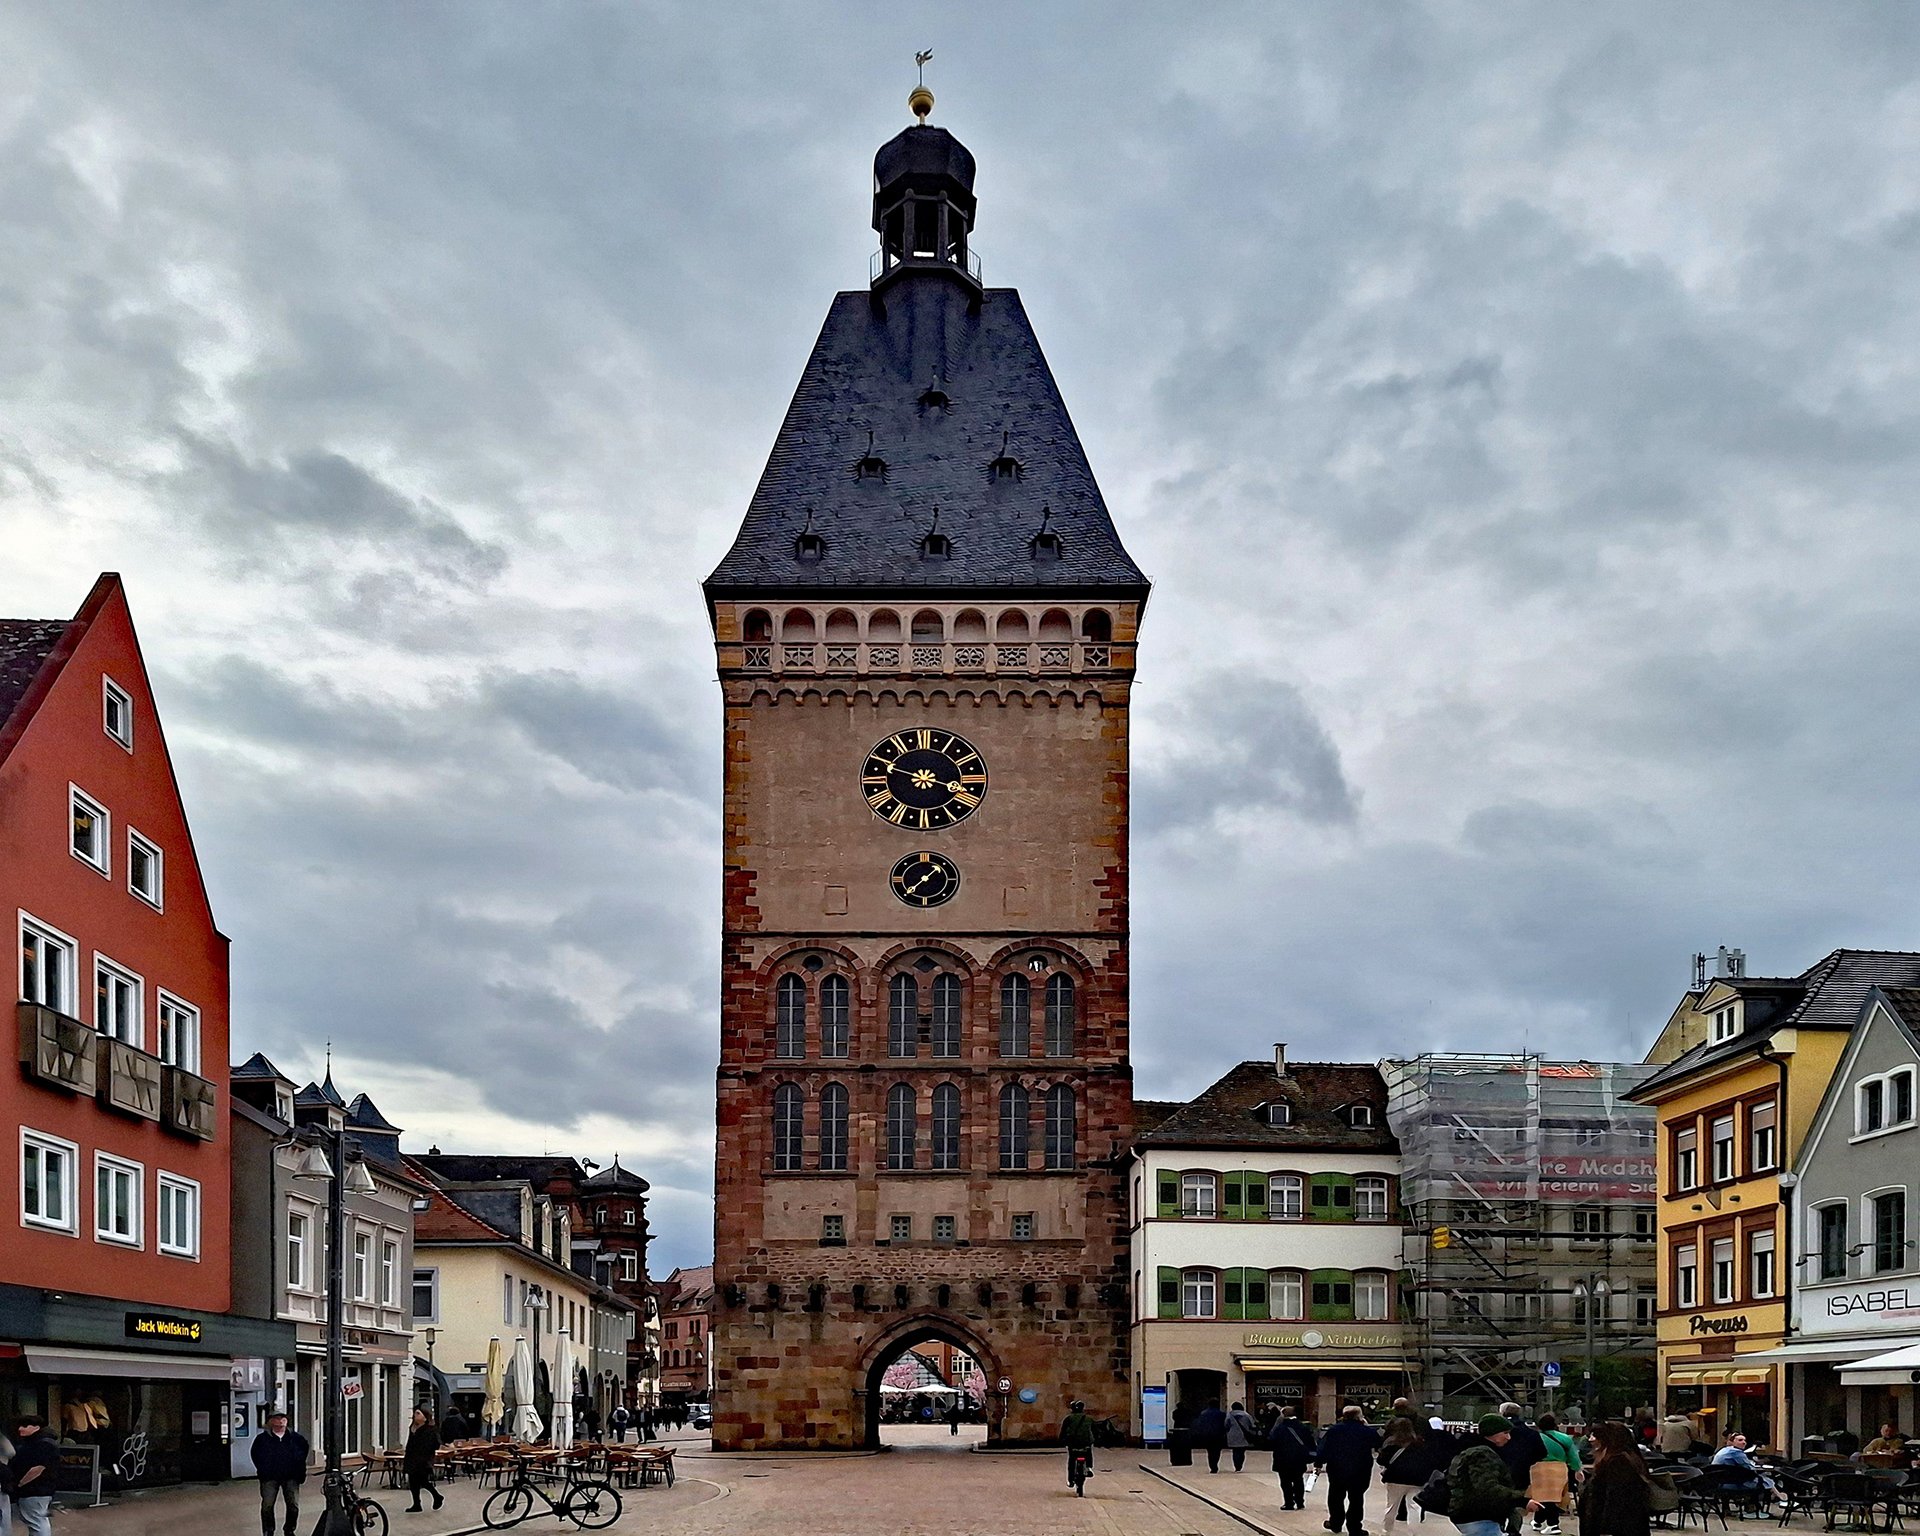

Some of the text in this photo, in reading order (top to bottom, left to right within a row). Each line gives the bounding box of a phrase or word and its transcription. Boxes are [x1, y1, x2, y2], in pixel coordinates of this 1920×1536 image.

[135, 1319, 189, 1336] Jack Wolfskin
[1688, 1315, 1748, 1336] Preuss
[1249, 1333, 1299, 1345] Blumen
